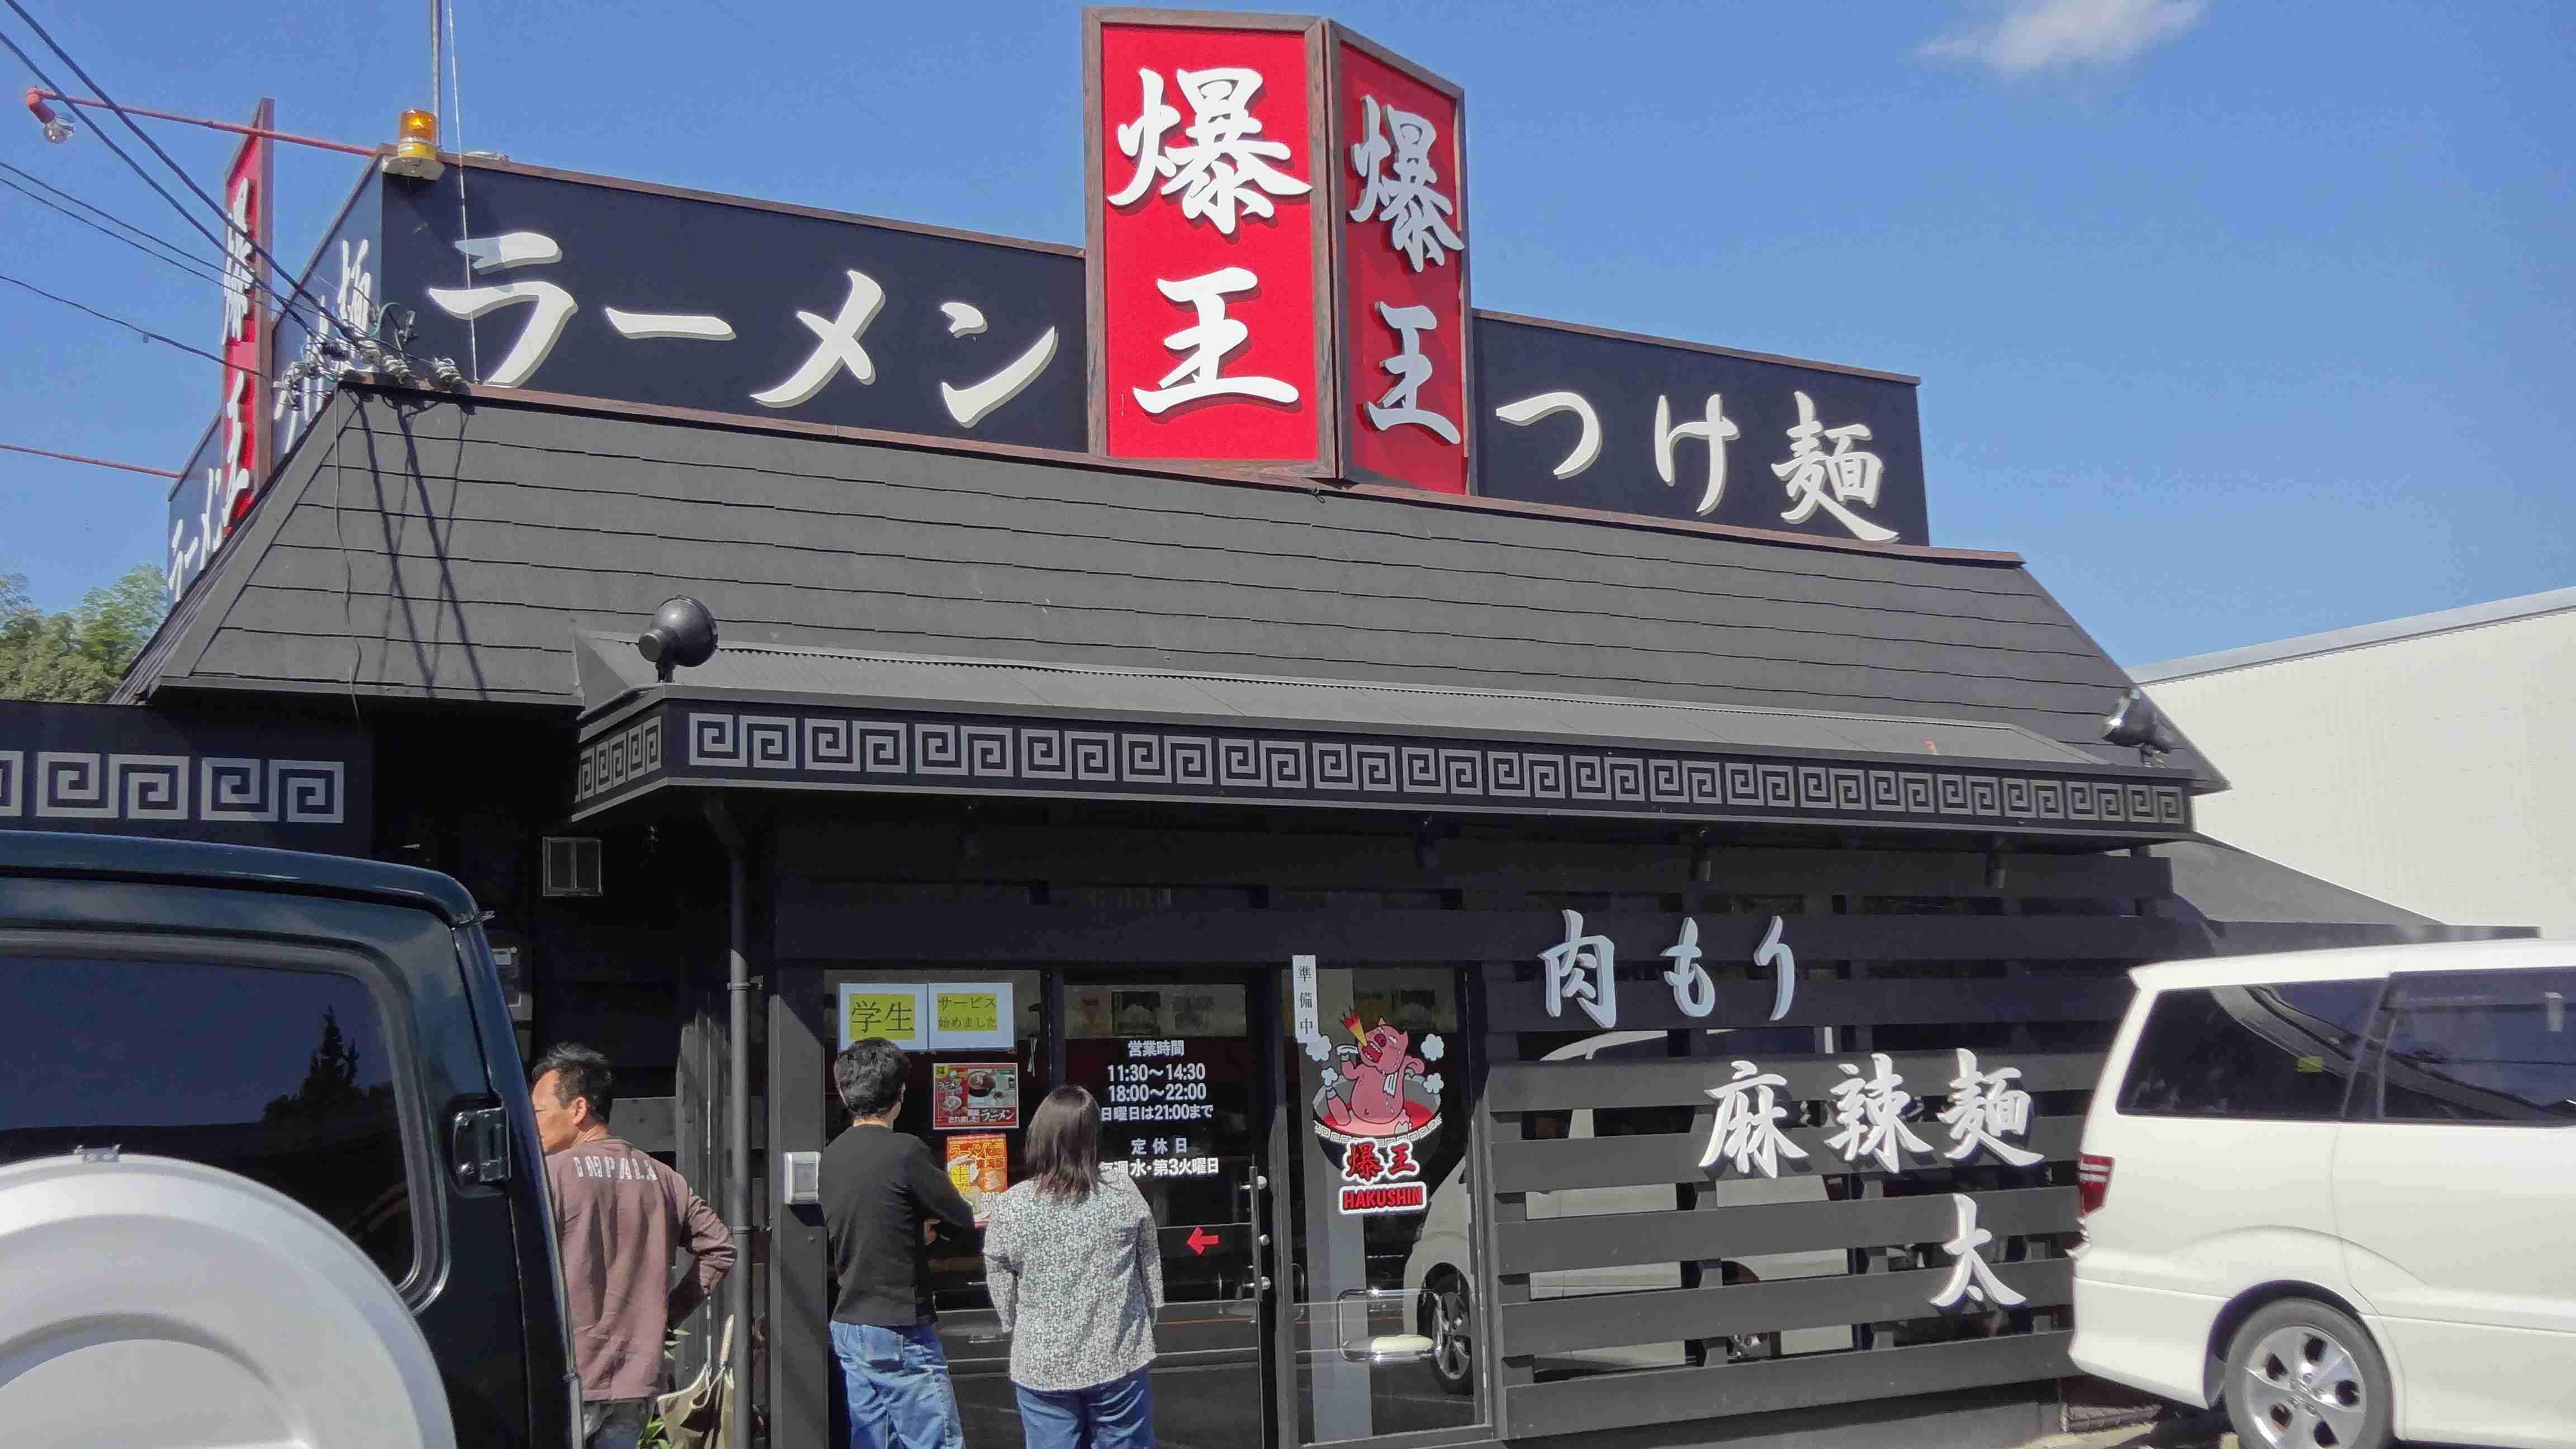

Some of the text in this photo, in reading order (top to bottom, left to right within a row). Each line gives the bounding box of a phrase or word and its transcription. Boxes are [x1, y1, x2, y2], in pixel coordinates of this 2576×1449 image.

[1107, 68, 1313, 414] 爆王
[1349, 94, 1465, 445] 爆王
[428, 231, 1058, 428] ラーメン
[1496, 390, 1901, 542] つけ麺
[1538, 909, 1796, 1029] 肉もり
[851, 1000, 915, 1034] 学生
[937, 996, 997, 1011] サービス
[1298, 965, 1313, 1035] 準備中
[938, 1016, 998, 1030] 始めました
[1128, 1040, 1185, 1057] 営業時間
[1107, 1063, 1205, 1082] 11:30～14:30
[1109, 1083, 1206, 1102] 18:00～22:00
[1100, 1104, 1214, 1121] 日曜日は21:00まで
[1698, 1047, 2044, 1178] 麻辣麺
[1345, 1141, 1416, 1182] 爆王
[1342, 1186, 1424, 1211] HAKUSHIN
[1929, 1194, 2027, 1307] 太
